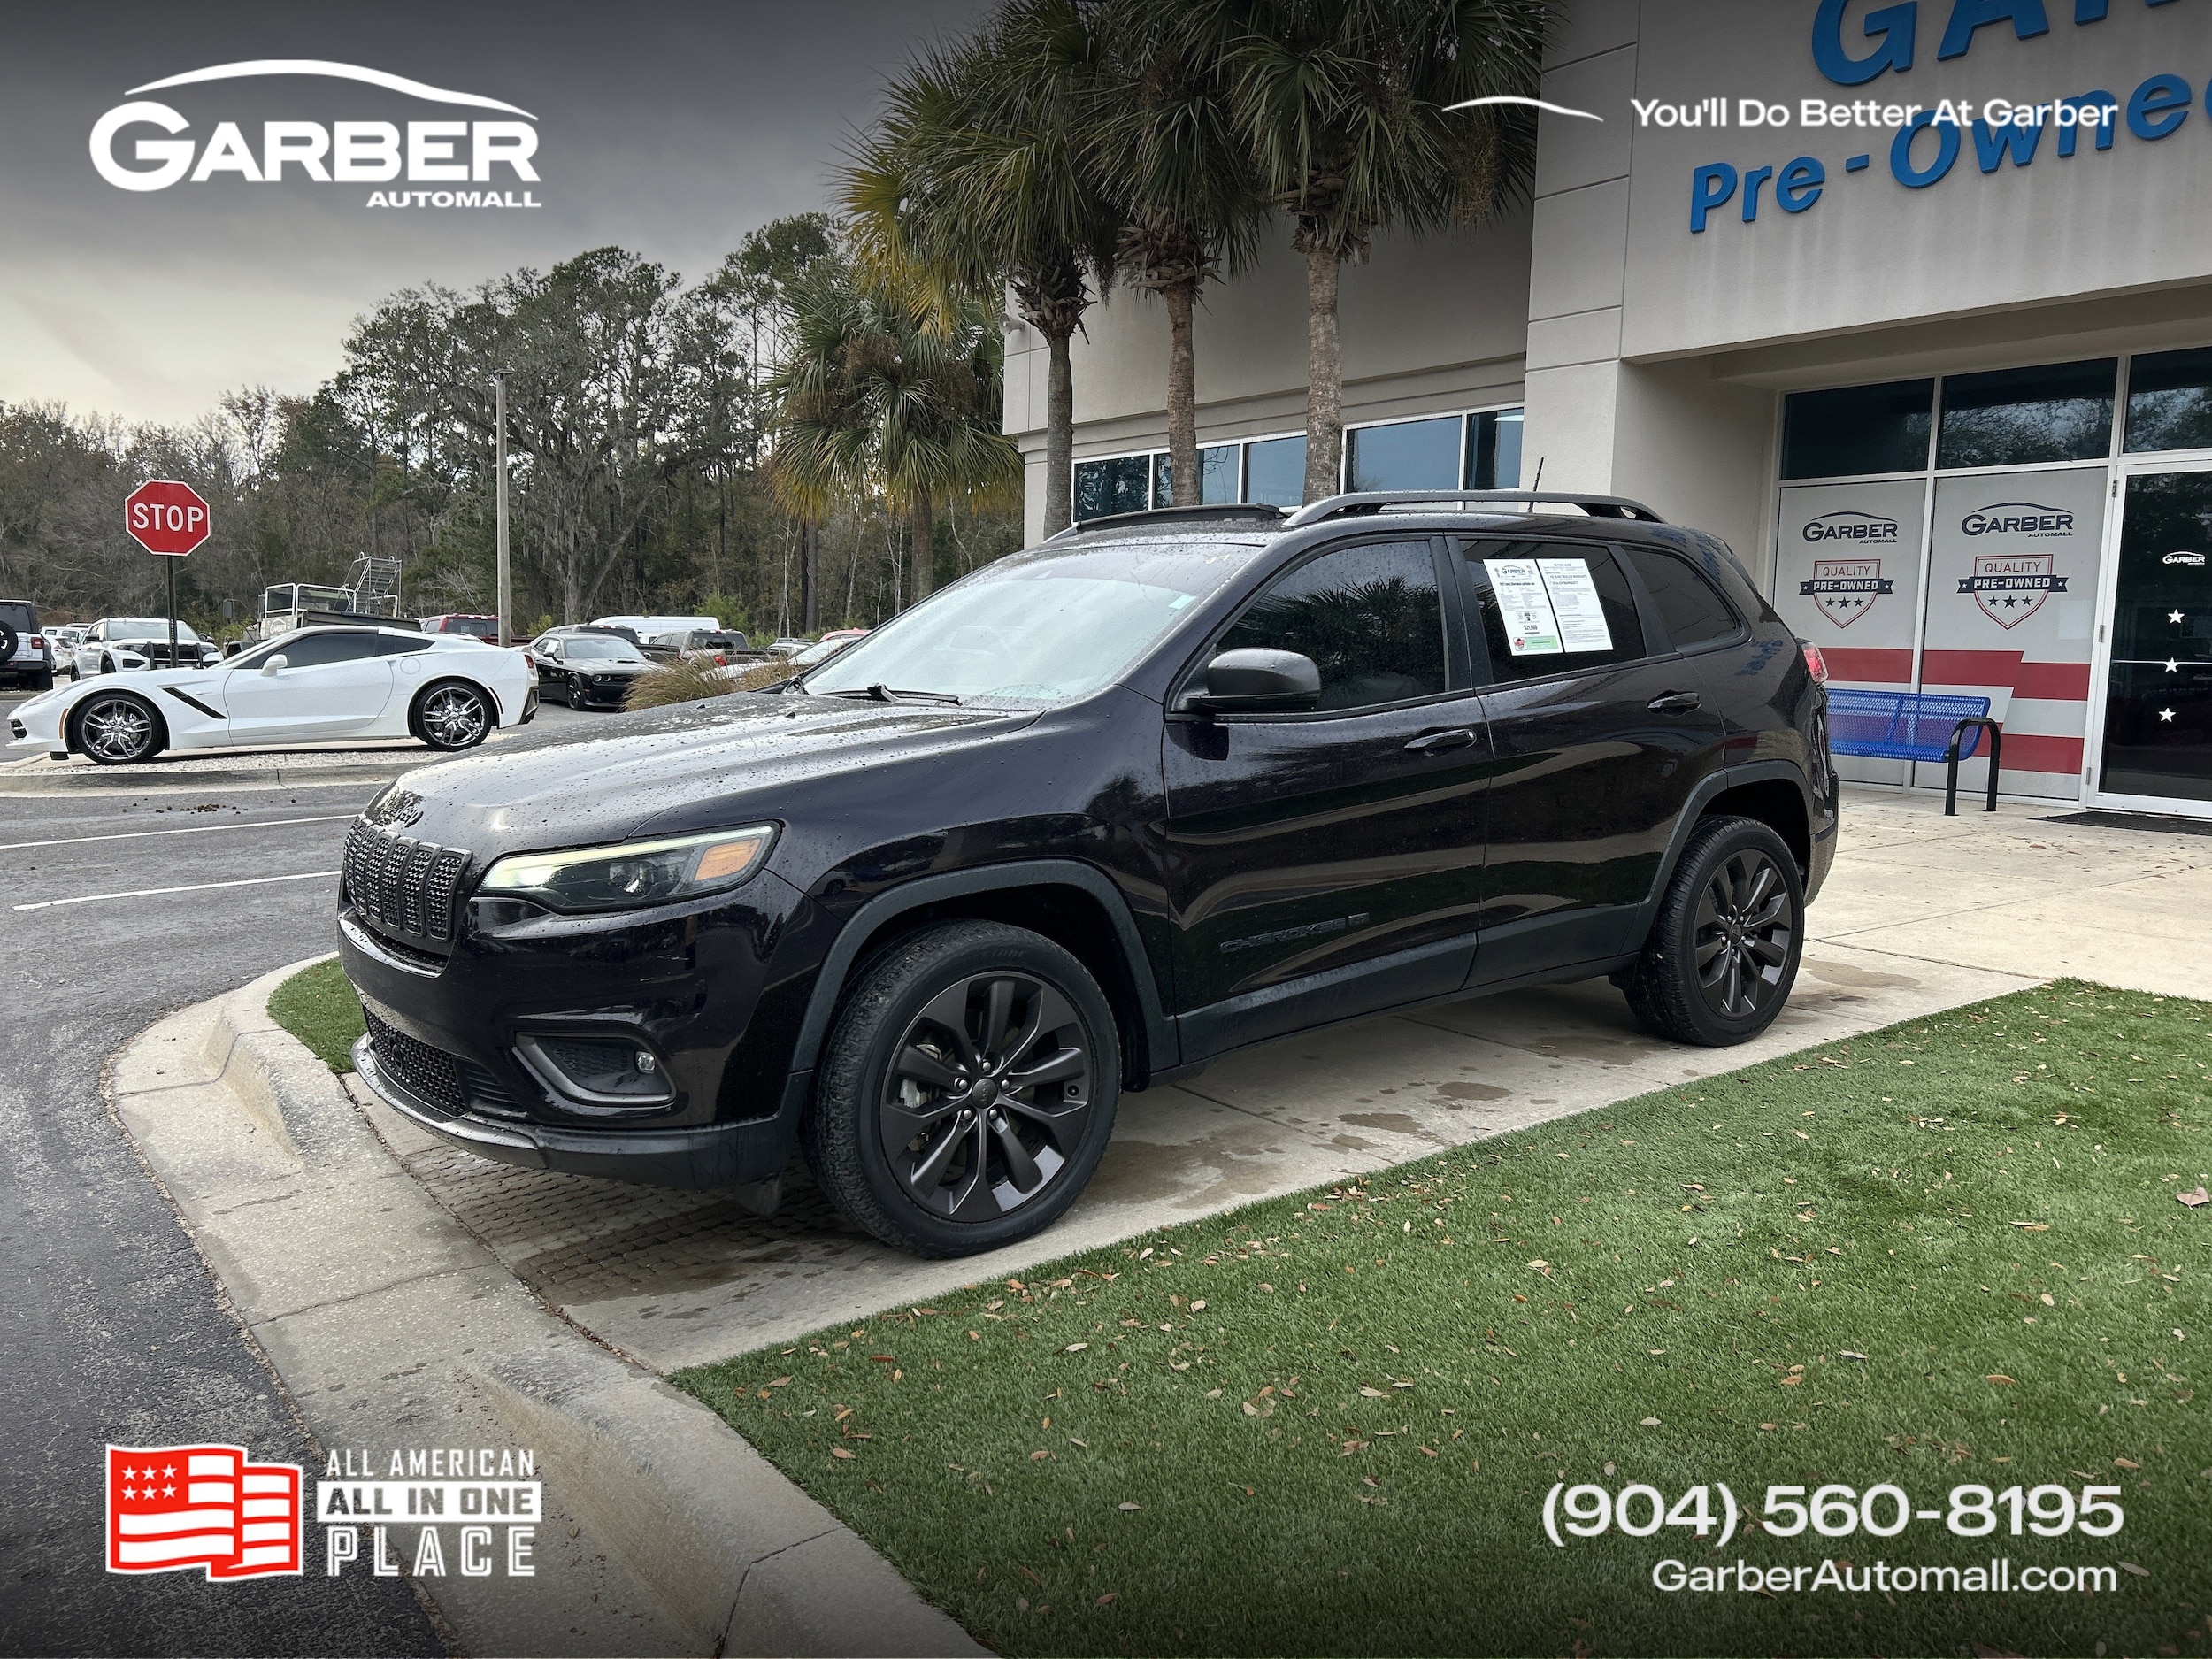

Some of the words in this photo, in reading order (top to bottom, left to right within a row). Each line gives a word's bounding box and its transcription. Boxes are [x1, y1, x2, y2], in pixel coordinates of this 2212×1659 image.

[1691, 73, 2212, 234] Pre-Owne
[133, 503, 204, 533] STOP
[1962, 514, 2074, 536] GARBER
[1802, 522, 1898, 542] GARBER
[1823, 565, 1870, 577] QUALITY
[1985, 561, 2041, 573] QUALITY
[1813, 580, 1878, 591] PRE-OWNED
[1973, 577, 2051, 588] PRE-OWNED
